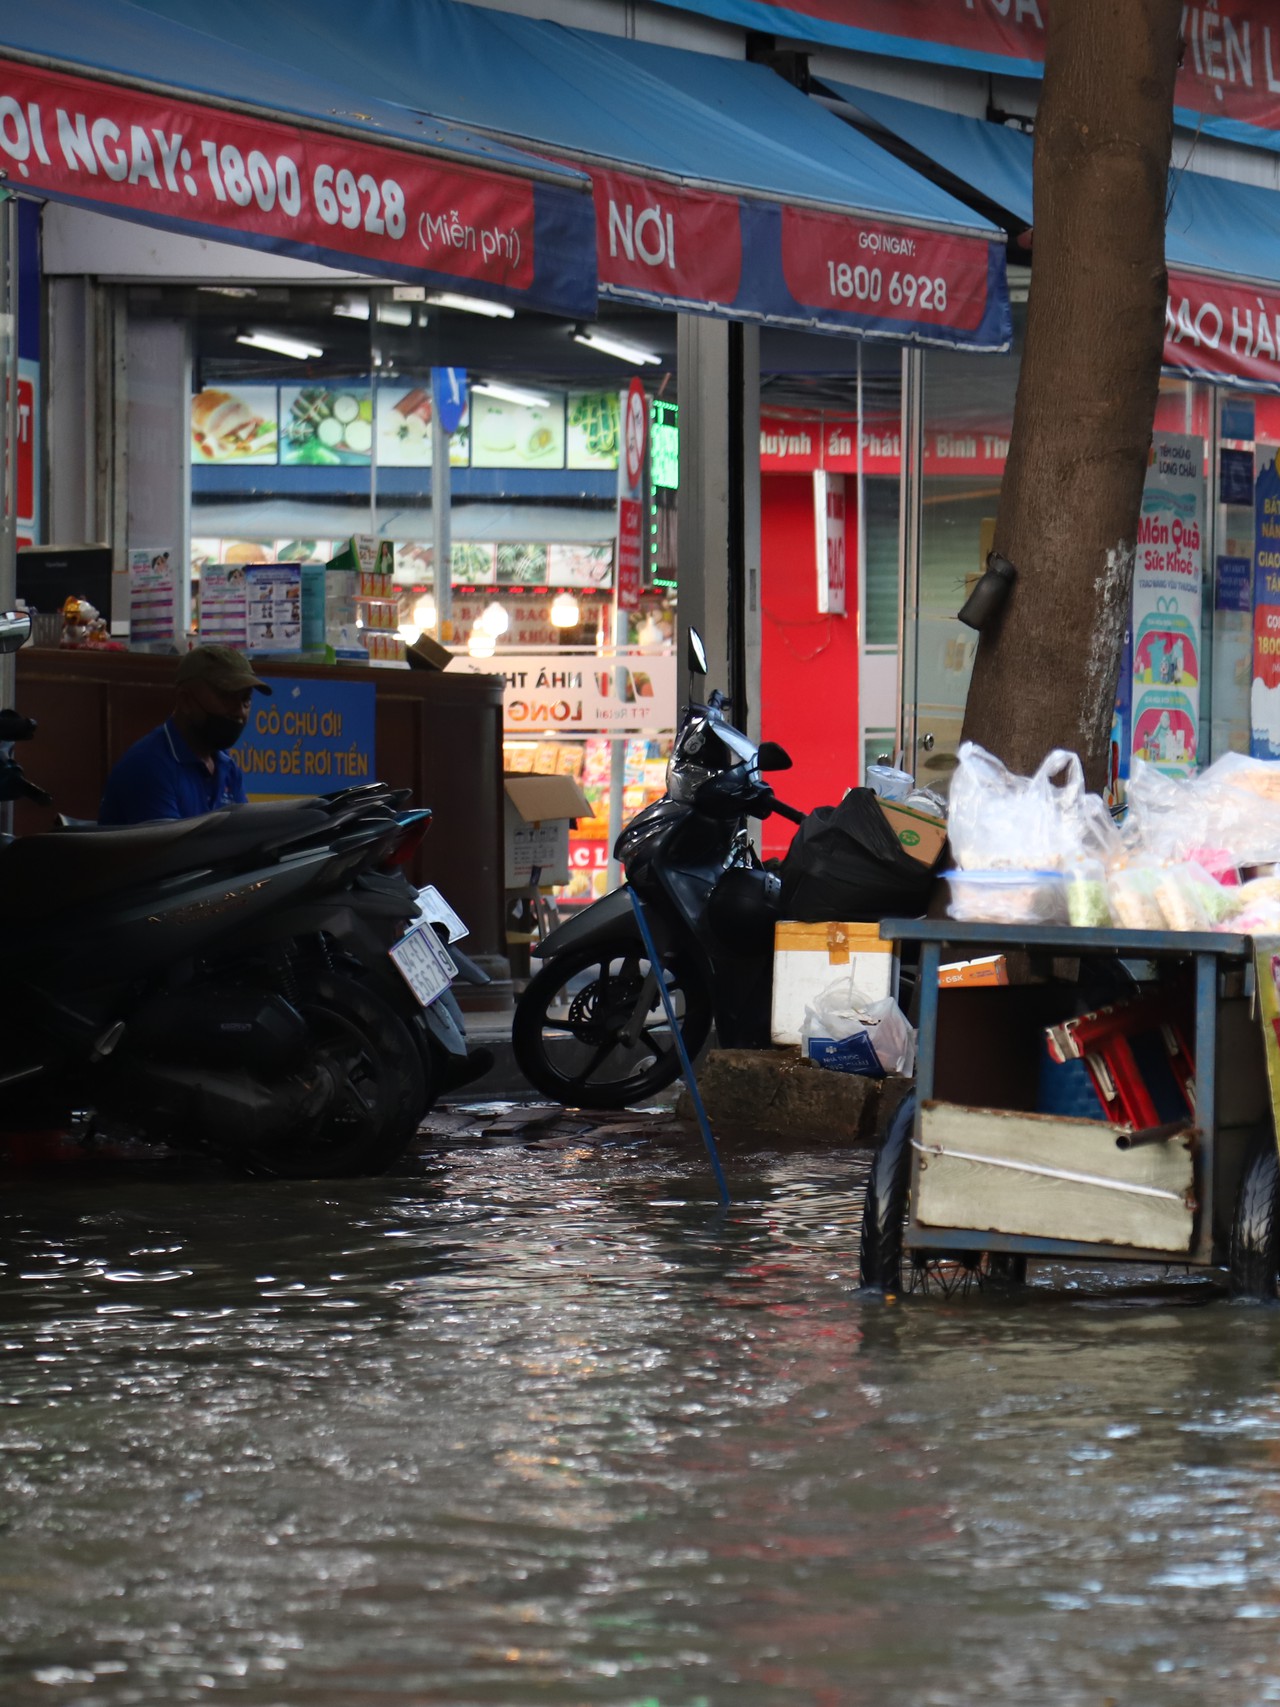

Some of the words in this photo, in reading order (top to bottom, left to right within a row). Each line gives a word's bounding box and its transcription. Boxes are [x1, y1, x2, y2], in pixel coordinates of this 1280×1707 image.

[1181, 0, 1253, 101] IỆN
[56, 107, 199, 197] NGAY:
[201, 140, 301, 218] 1800
[313, 163, 406, 240] 6928
[418, 209, 476, 252] (Miễn
[481, 226, 520, 269] phí)
[608, 200, 676, 270] NƠI
[859, 232, 881, 255] GỌI
[883, 236, 916, 257] NGAY:
[827, 261, 882, 302] 1800
[888, 271, 947, 312] 6928
[1165, 295, 1223, 349] IAO
[1137, 516, 1168, 545] Món
[1172, 518, 1200, 554] Quà
[1258, 550, 1280, 568] GIAO
[1267, 614, 1280, 632] GỌI
[255, 703, 281, 735] CÔ
[283, 705, 318, 736] CHÚ
[320, 709, 342, 737] ƠI!
[279, 738, 303, 774] ĐỂ
[305, 749, 331, 776] RƠI
